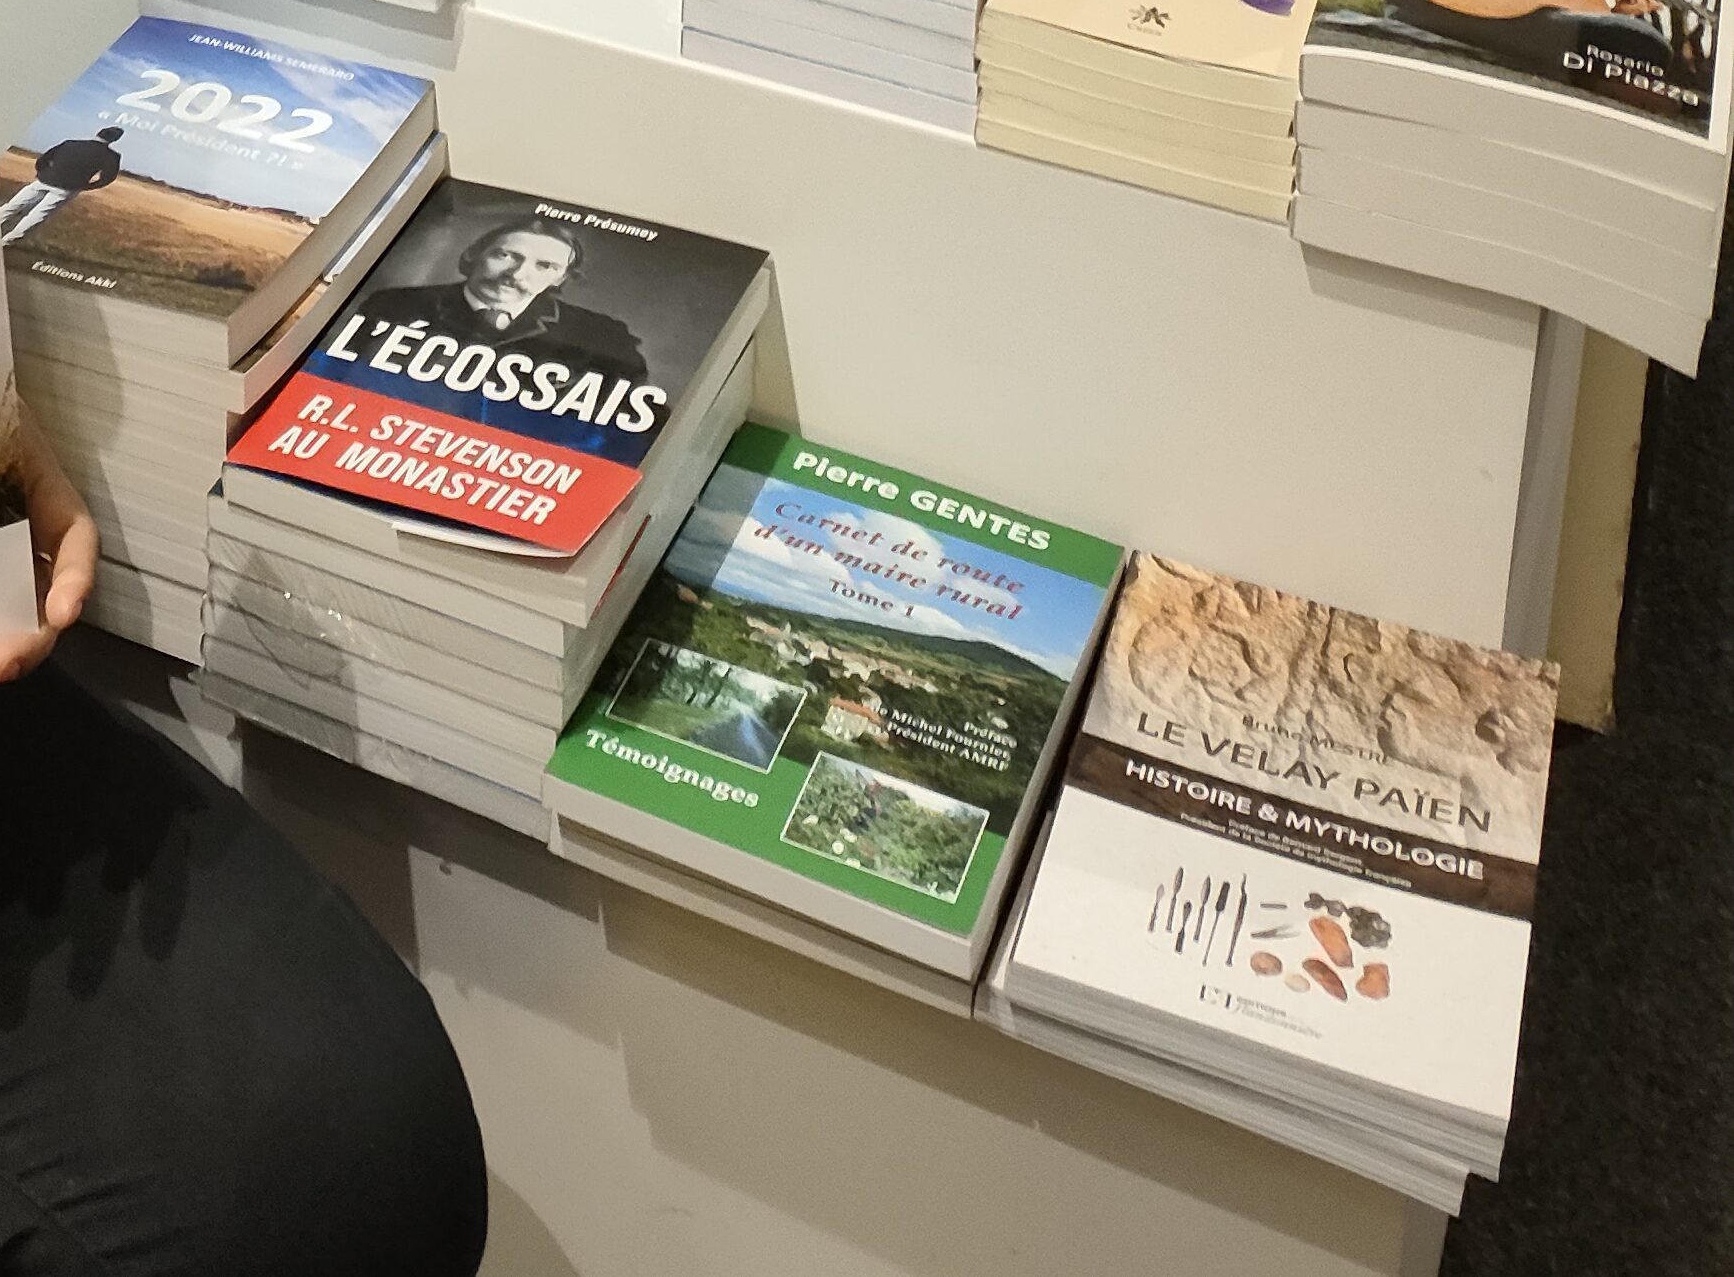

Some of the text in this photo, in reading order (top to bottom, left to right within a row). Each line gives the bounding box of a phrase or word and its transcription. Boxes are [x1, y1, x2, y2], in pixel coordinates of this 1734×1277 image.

[1587, 44, 1665, 78] Rosario
[1604, 62, 1700, 107] Piazza
[115, 68, 334, 155] 2022
[115, 110, 158, 133] Moi
[160, 123, 262, 161] Président
[534, 201, 581, 225] Pierre
[325, 313, 668, 435] L'ÉCOSSAIS
[267, 426, 557, 526] AU MONASTIER
[297, 394, 582, 495] R.L. STEVENSON
[794, 450, 1052, 552] Pierre GENTES
[754, 524, 1024, 623] d'un maire rural
[774, 500, 1026, 596] Carnet de route
[828, 579, 897, 613] Tome
[888, 721, 956, 754] Président
[892, 709, 943, 736] Michel
[964, 721, 1017, 749] Préface
[585, 729, 760, 809] Témoignages
[1136, 711, 1494, 834] LE VELAY PAÏEN
[1125, 758, 1486, 881] HISTOIRE & MYTHOLOGIE
